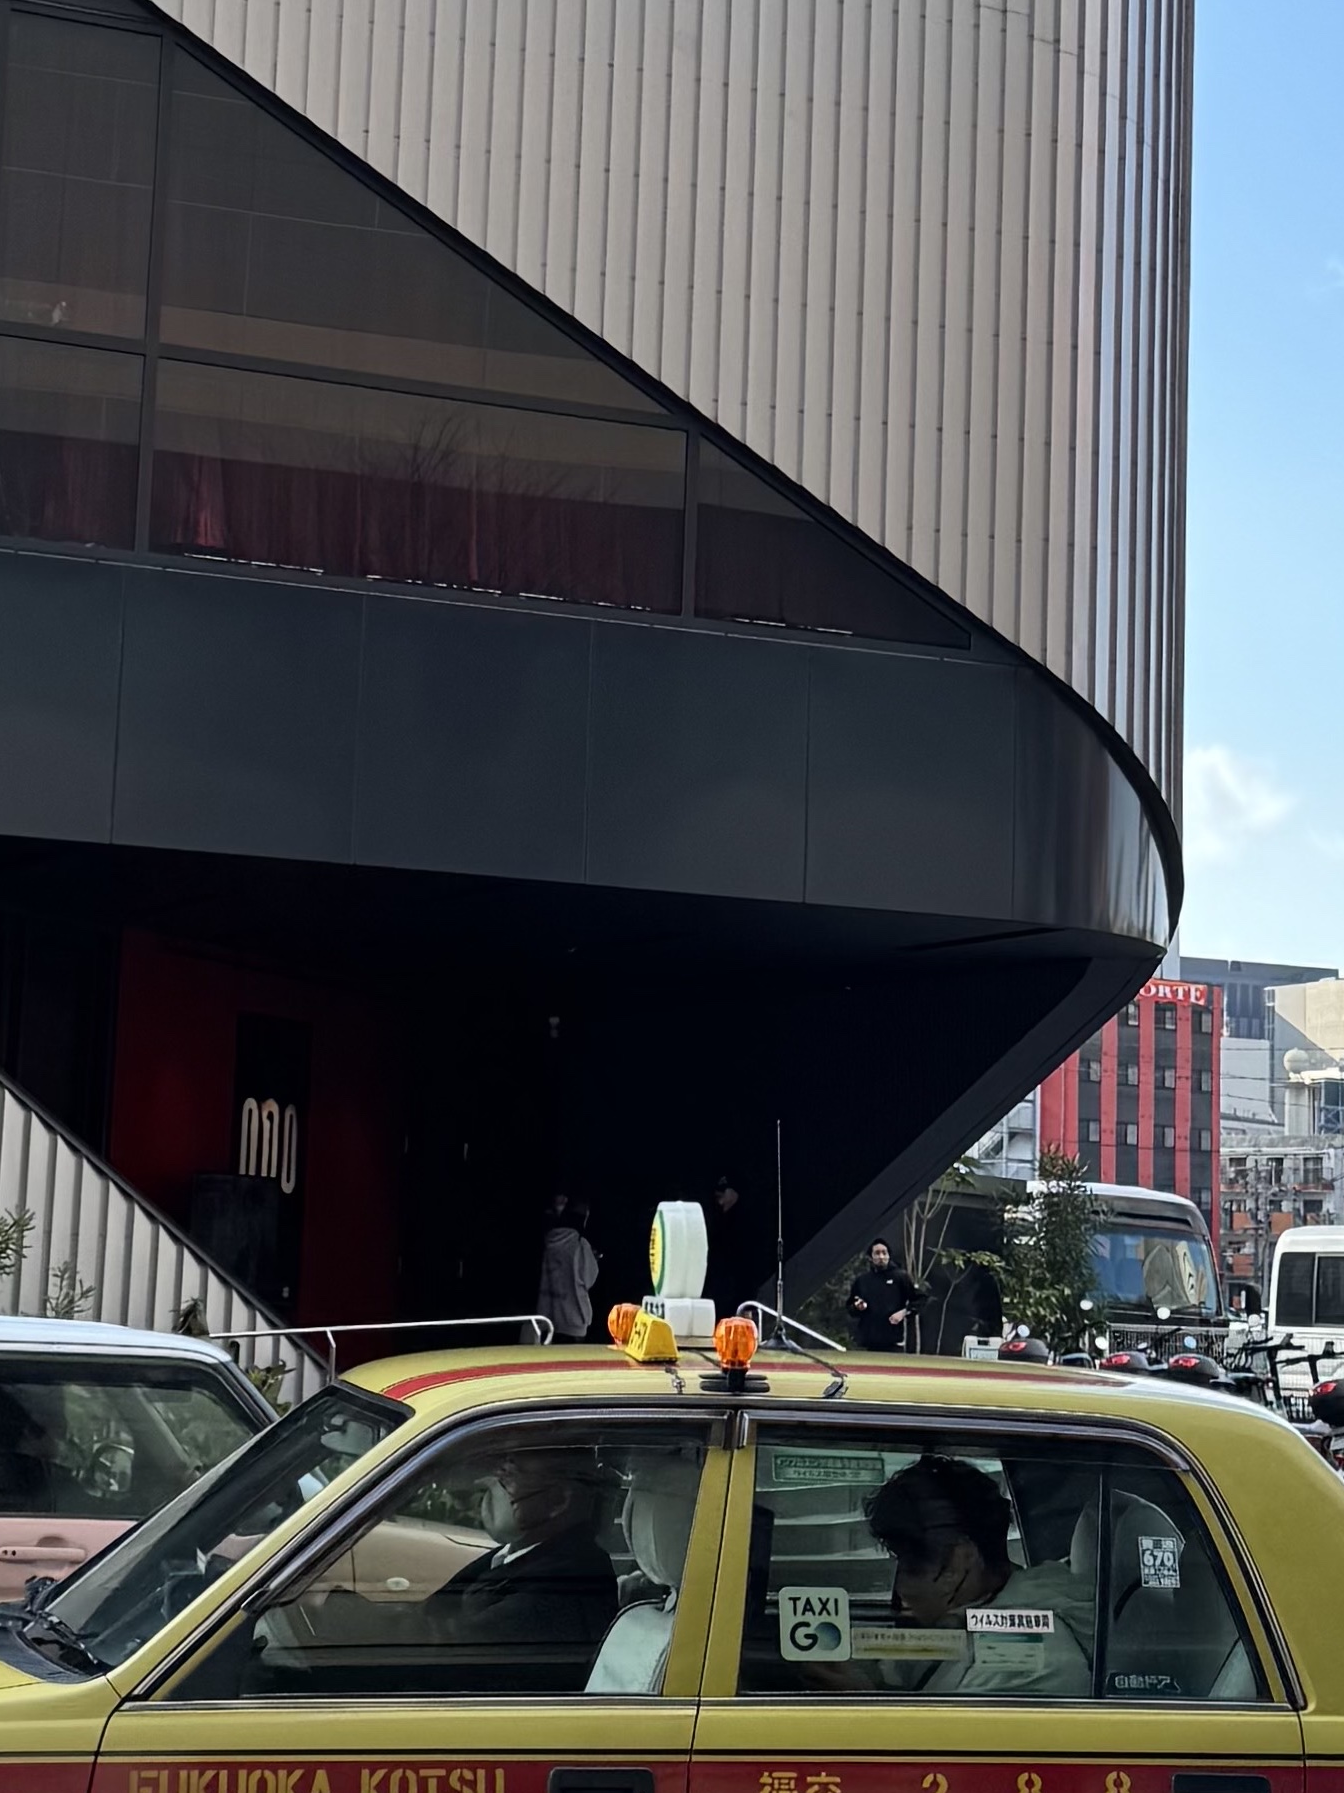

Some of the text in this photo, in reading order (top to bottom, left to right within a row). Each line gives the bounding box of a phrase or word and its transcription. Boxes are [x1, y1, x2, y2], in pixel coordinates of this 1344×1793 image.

[1143, 1549, 1174, 1567] 670
[788, 1597, 838, 1616] TAXI
[790, 1621, 842, 1651] GO
